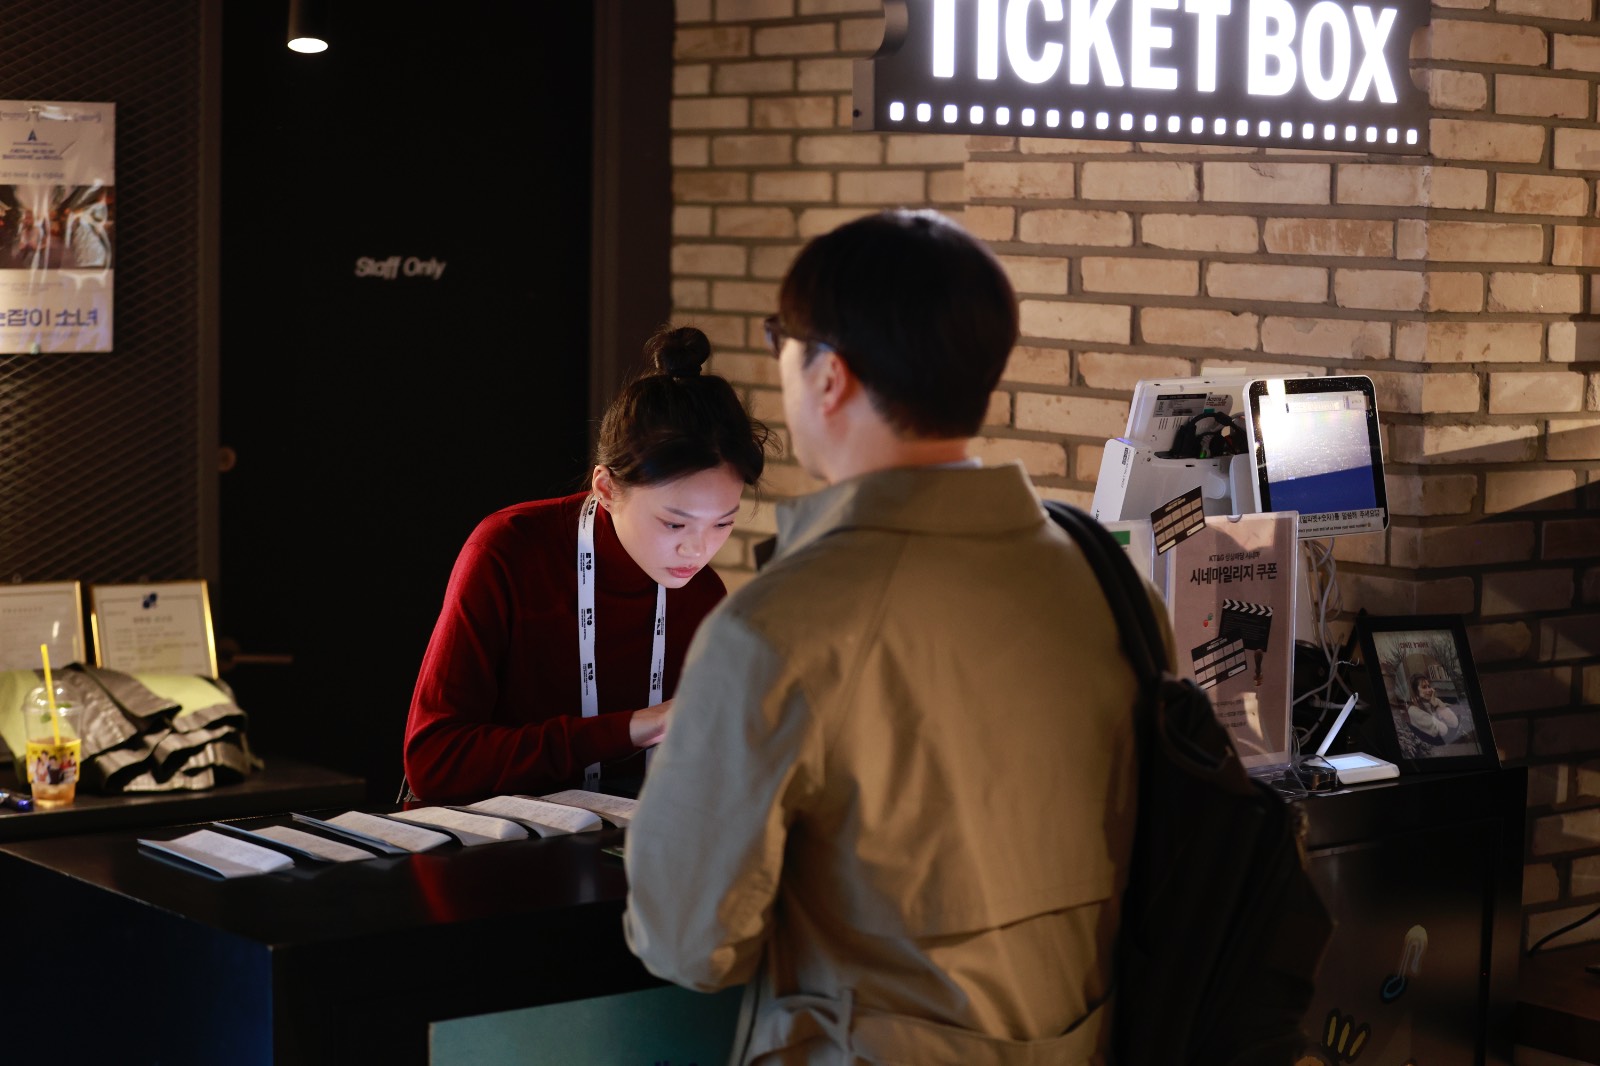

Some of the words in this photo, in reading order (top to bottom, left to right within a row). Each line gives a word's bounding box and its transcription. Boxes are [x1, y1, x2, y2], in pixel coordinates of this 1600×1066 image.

[932, 0, 1232, 92] TICKET
[1247, 0, 1398, 104] BOX
[355, 256, 402, 279] Staff
[403, 256, 447, 280] Only
[55, 308, 98, 327] 소녀
[1190, 564, 1254, 585] 시네마일리지
[1256, 562, 1278, 581] 쿠폰
